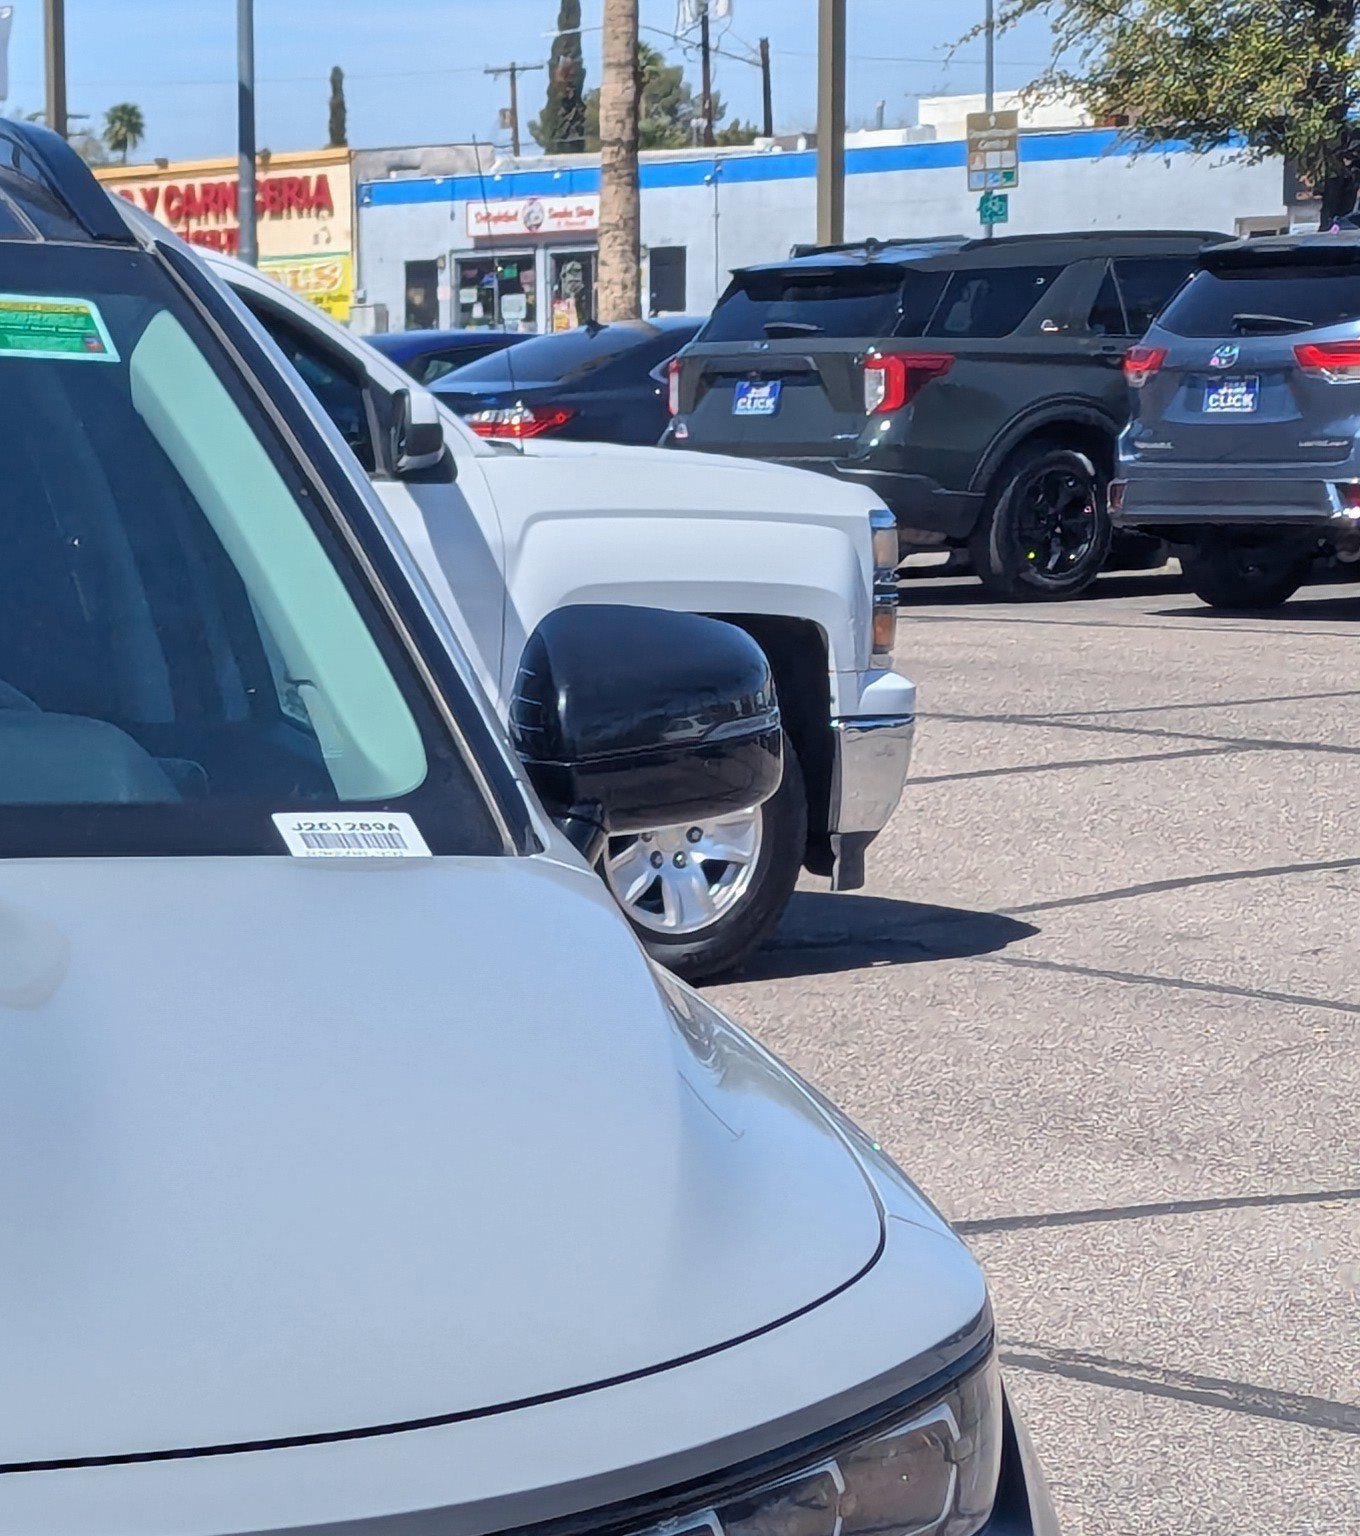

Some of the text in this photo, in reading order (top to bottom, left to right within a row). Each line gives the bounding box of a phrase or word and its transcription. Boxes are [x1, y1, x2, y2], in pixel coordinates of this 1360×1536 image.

[164, 174, 334, 224] CARNCERIA
[737, 396, 775, 411] CLICK
[1208, 394, 1254, 408] CLICK
